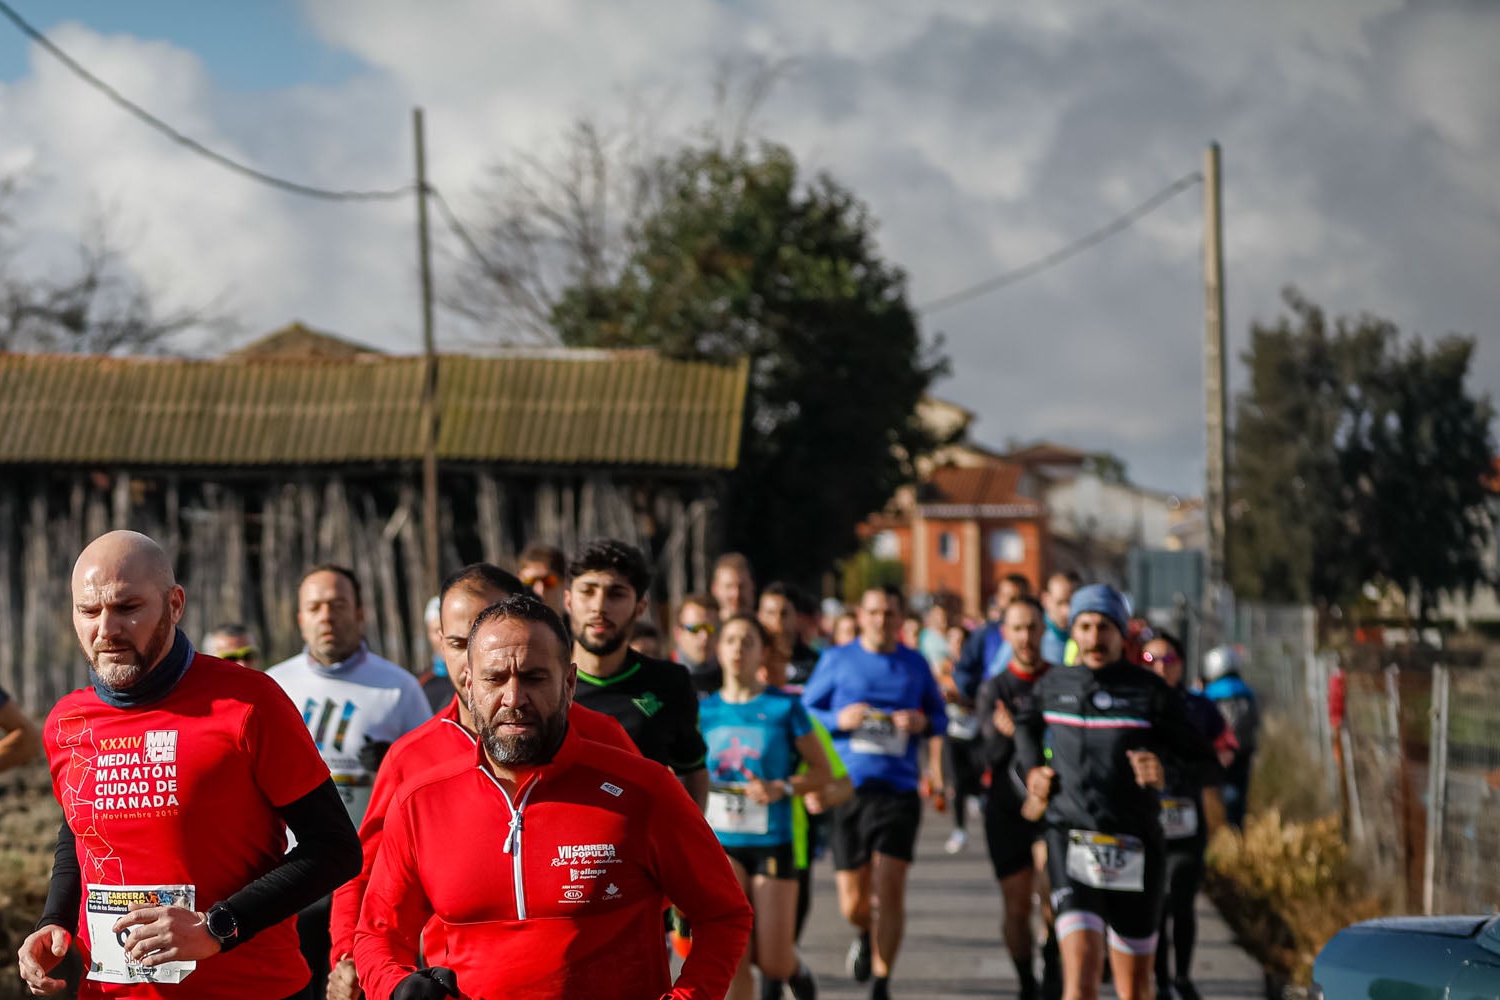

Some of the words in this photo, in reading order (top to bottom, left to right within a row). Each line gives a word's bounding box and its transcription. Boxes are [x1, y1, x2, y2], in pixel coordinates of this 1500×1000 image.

[100, 736, 142, 751] XXXIV
[97, 753, 141, 767] MEDIA
[96, 764, 177, 782] MARATÓN
[95, 781, 149, 796] CIUDAD
[156, 780, 178, 793] DE
[94, 794, 180, 810] GRANADA
[558, 846, 571, 858] VII
[572, 844, 615, 852] CARRERA
[108, 892, 145, 900] CARRERA
